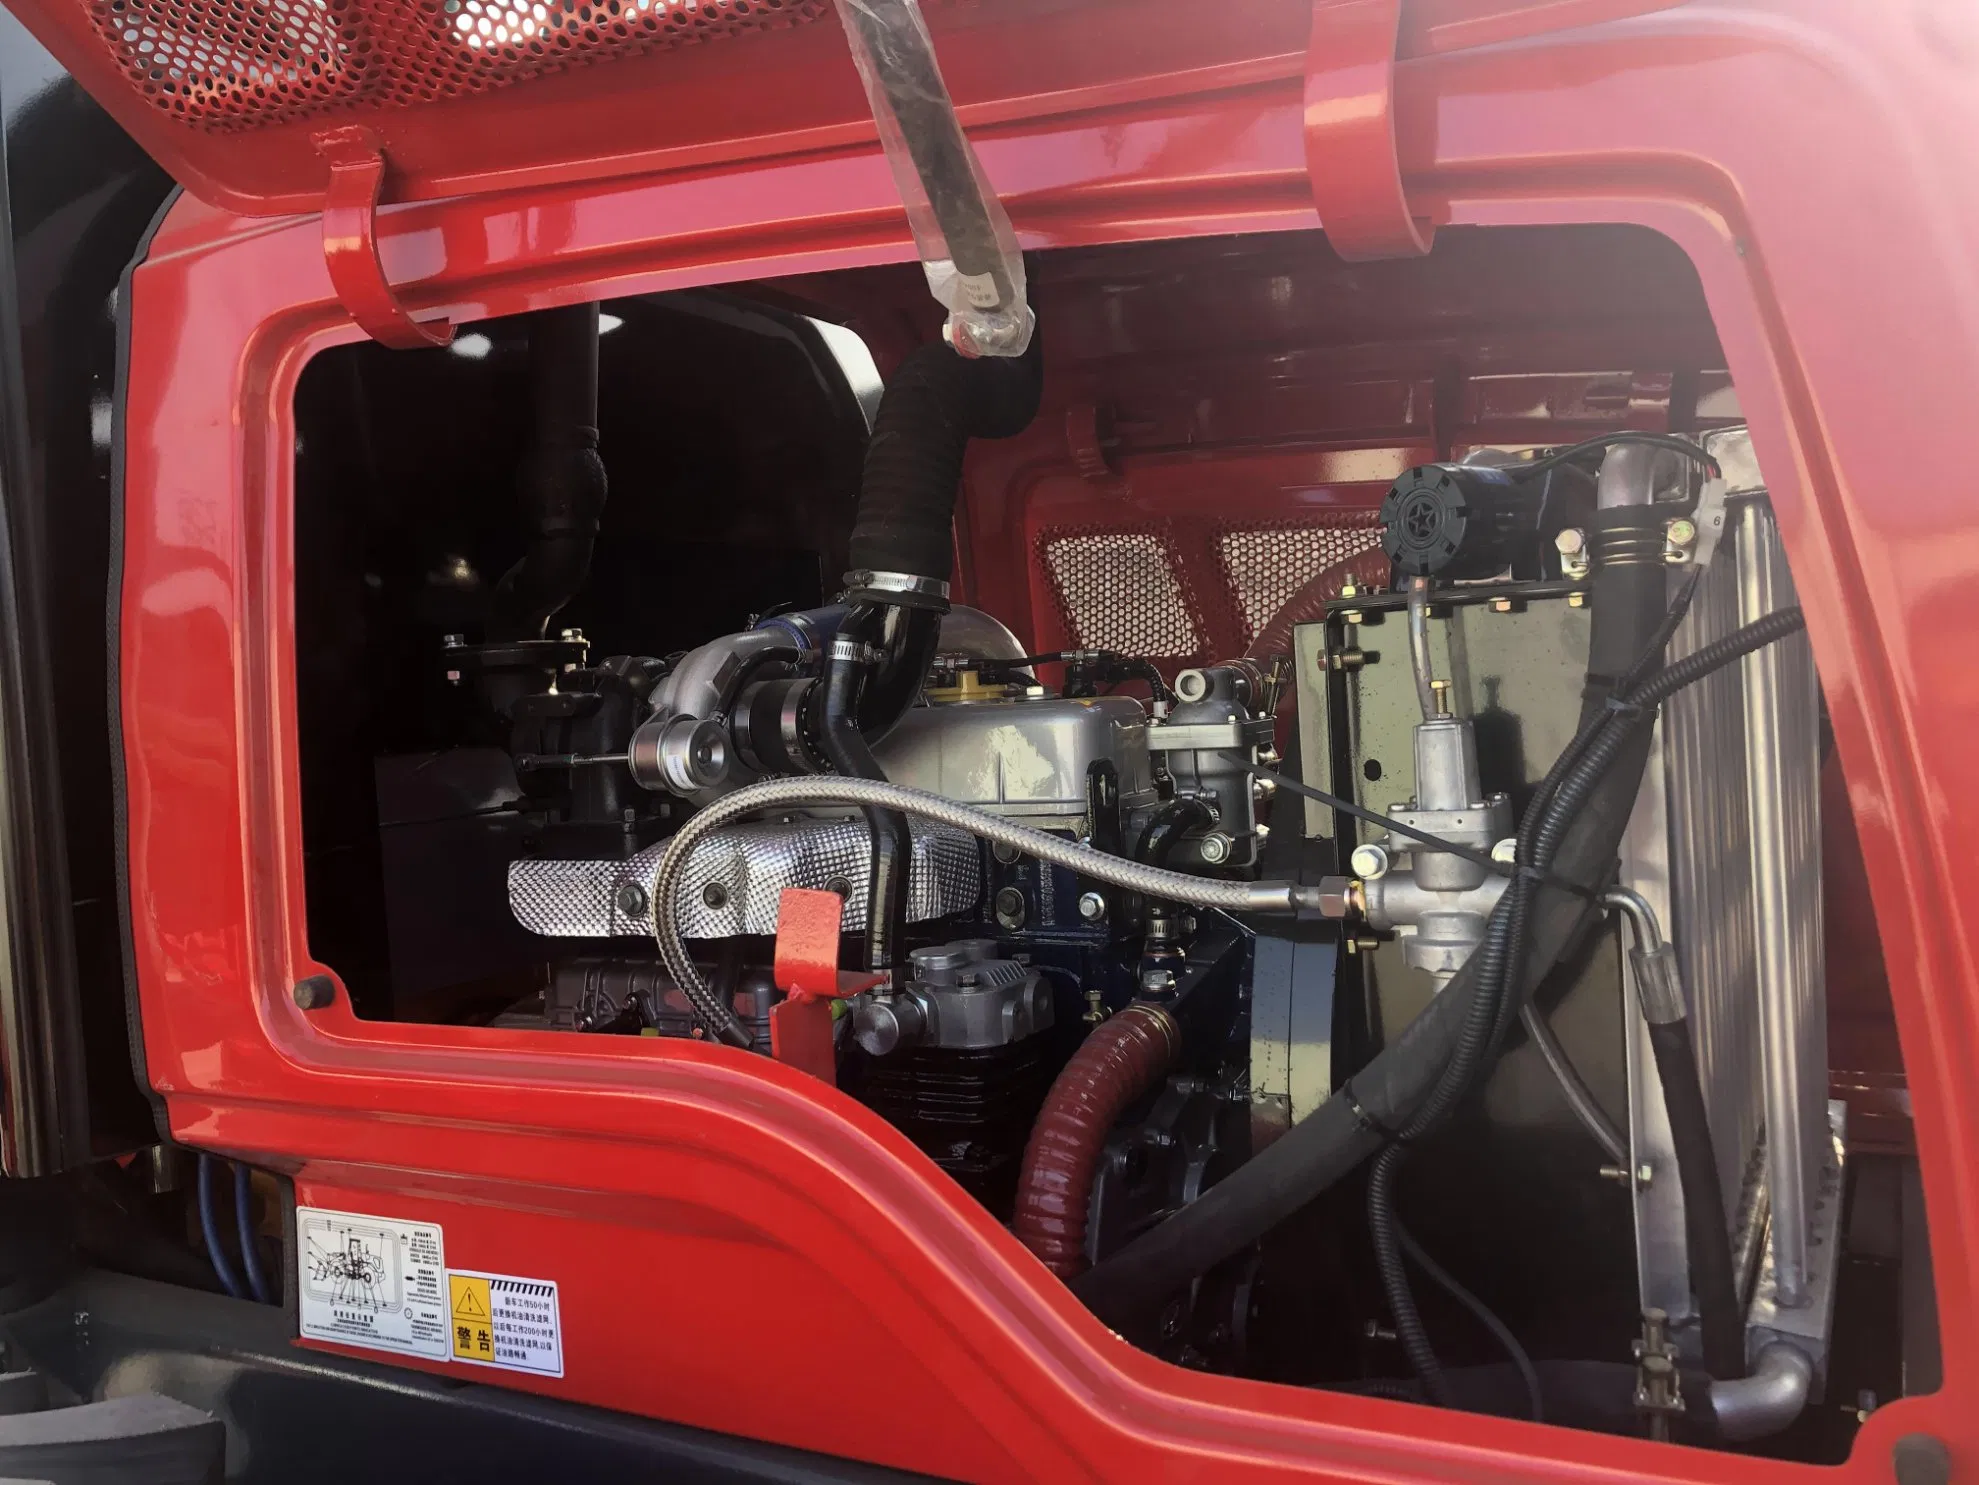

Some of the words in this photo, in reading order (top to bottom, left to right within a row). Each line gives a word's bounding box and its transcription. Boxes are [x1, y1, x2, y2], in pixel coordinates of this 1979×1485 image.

[1713, 515, 1721, 526] 6
[493, 1321, 554, 1339] 以后每工作200小时更
[456, 1326, 491, 1353] 警告
